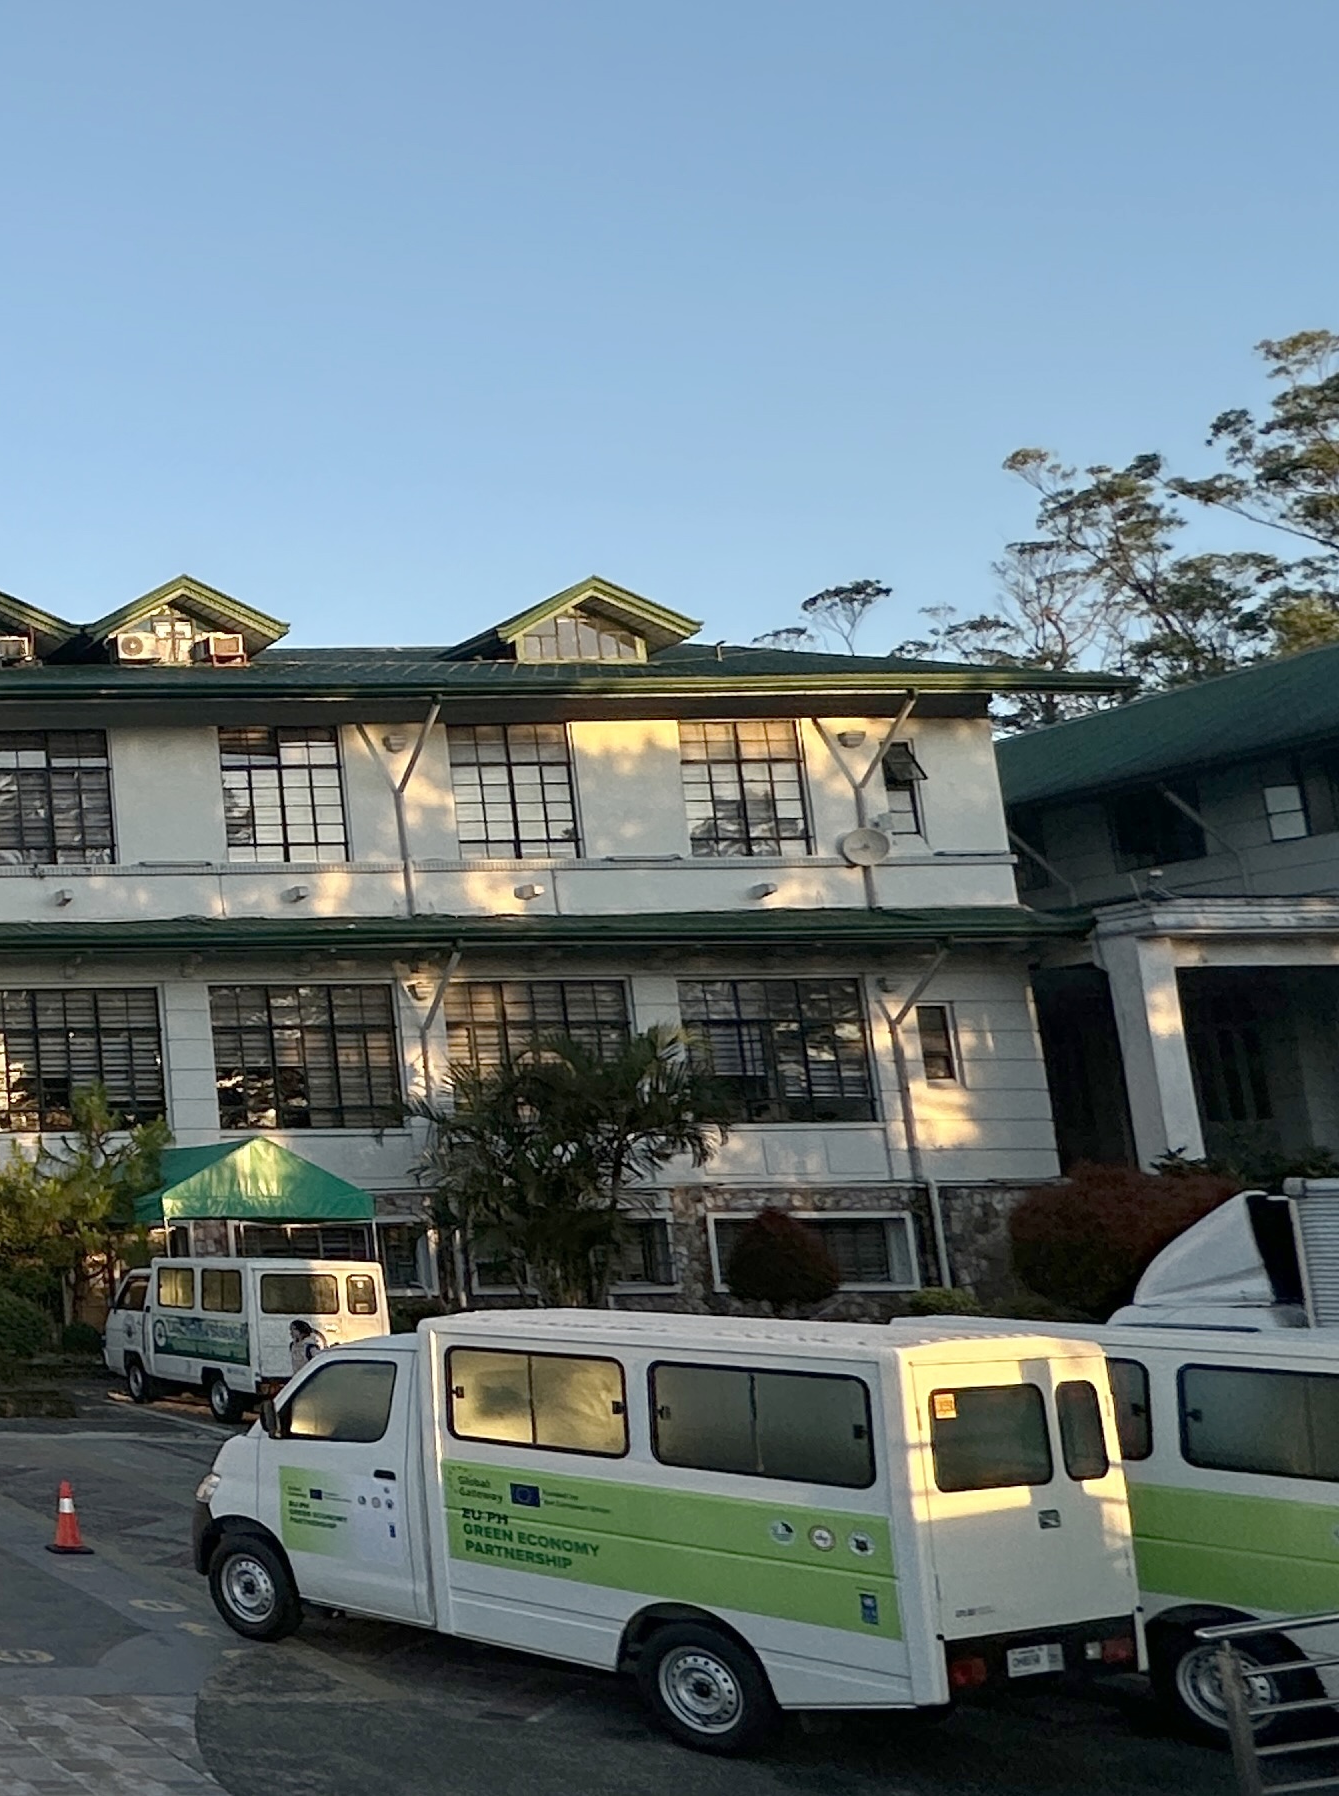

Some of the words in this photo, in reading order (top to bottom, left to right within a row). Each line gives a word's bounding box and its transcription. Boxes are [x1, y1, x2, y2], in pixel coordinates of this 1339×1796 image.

[457, 1475, 492, 1490] Global
[458, 1486, 504, 1505] Gateway
[463, 1523, 514, 1543] GREEN
[518, 1532, 600, 1557] ECONOMY
[465, 1539, 573, 1570] PARTNERSHIP
